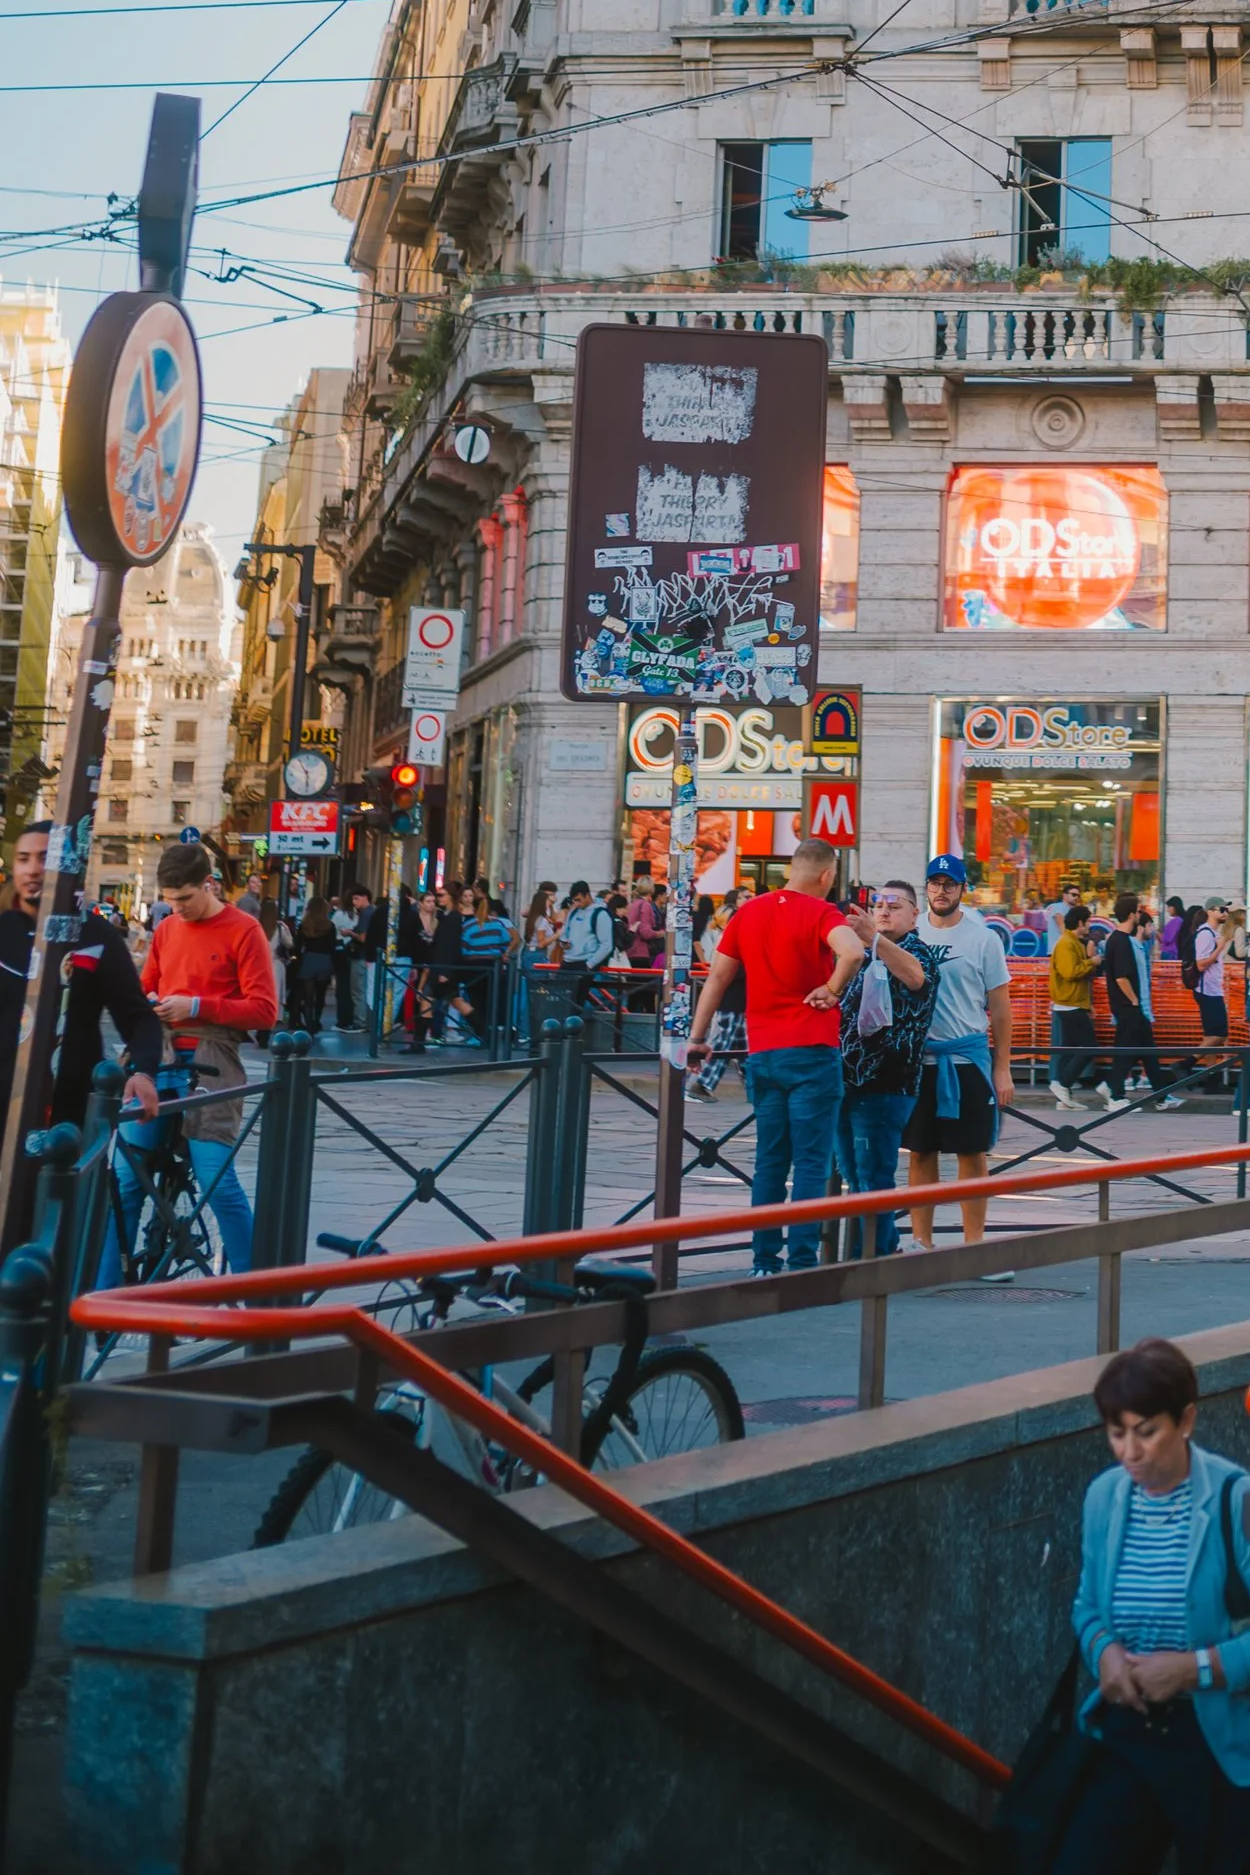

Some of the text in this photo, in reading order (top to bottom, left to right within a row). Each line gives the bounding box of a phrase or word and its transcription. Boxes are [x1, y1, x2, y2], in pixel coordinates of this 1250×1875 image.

[996, 561, 1116, 579] ITALIA
[632, 651, 694, 669] GLYFADA
[642, 665, 680, 678] Gate 13
[963, 705, 1130, 750] ODStore
[963, 756, 1132, 769] OVUNQUE DOLCE SALATO
[718, 785, 770, 800] DOLCE
[280, 801, 330, 821] KFC
[811, 794, 855, 835] M
